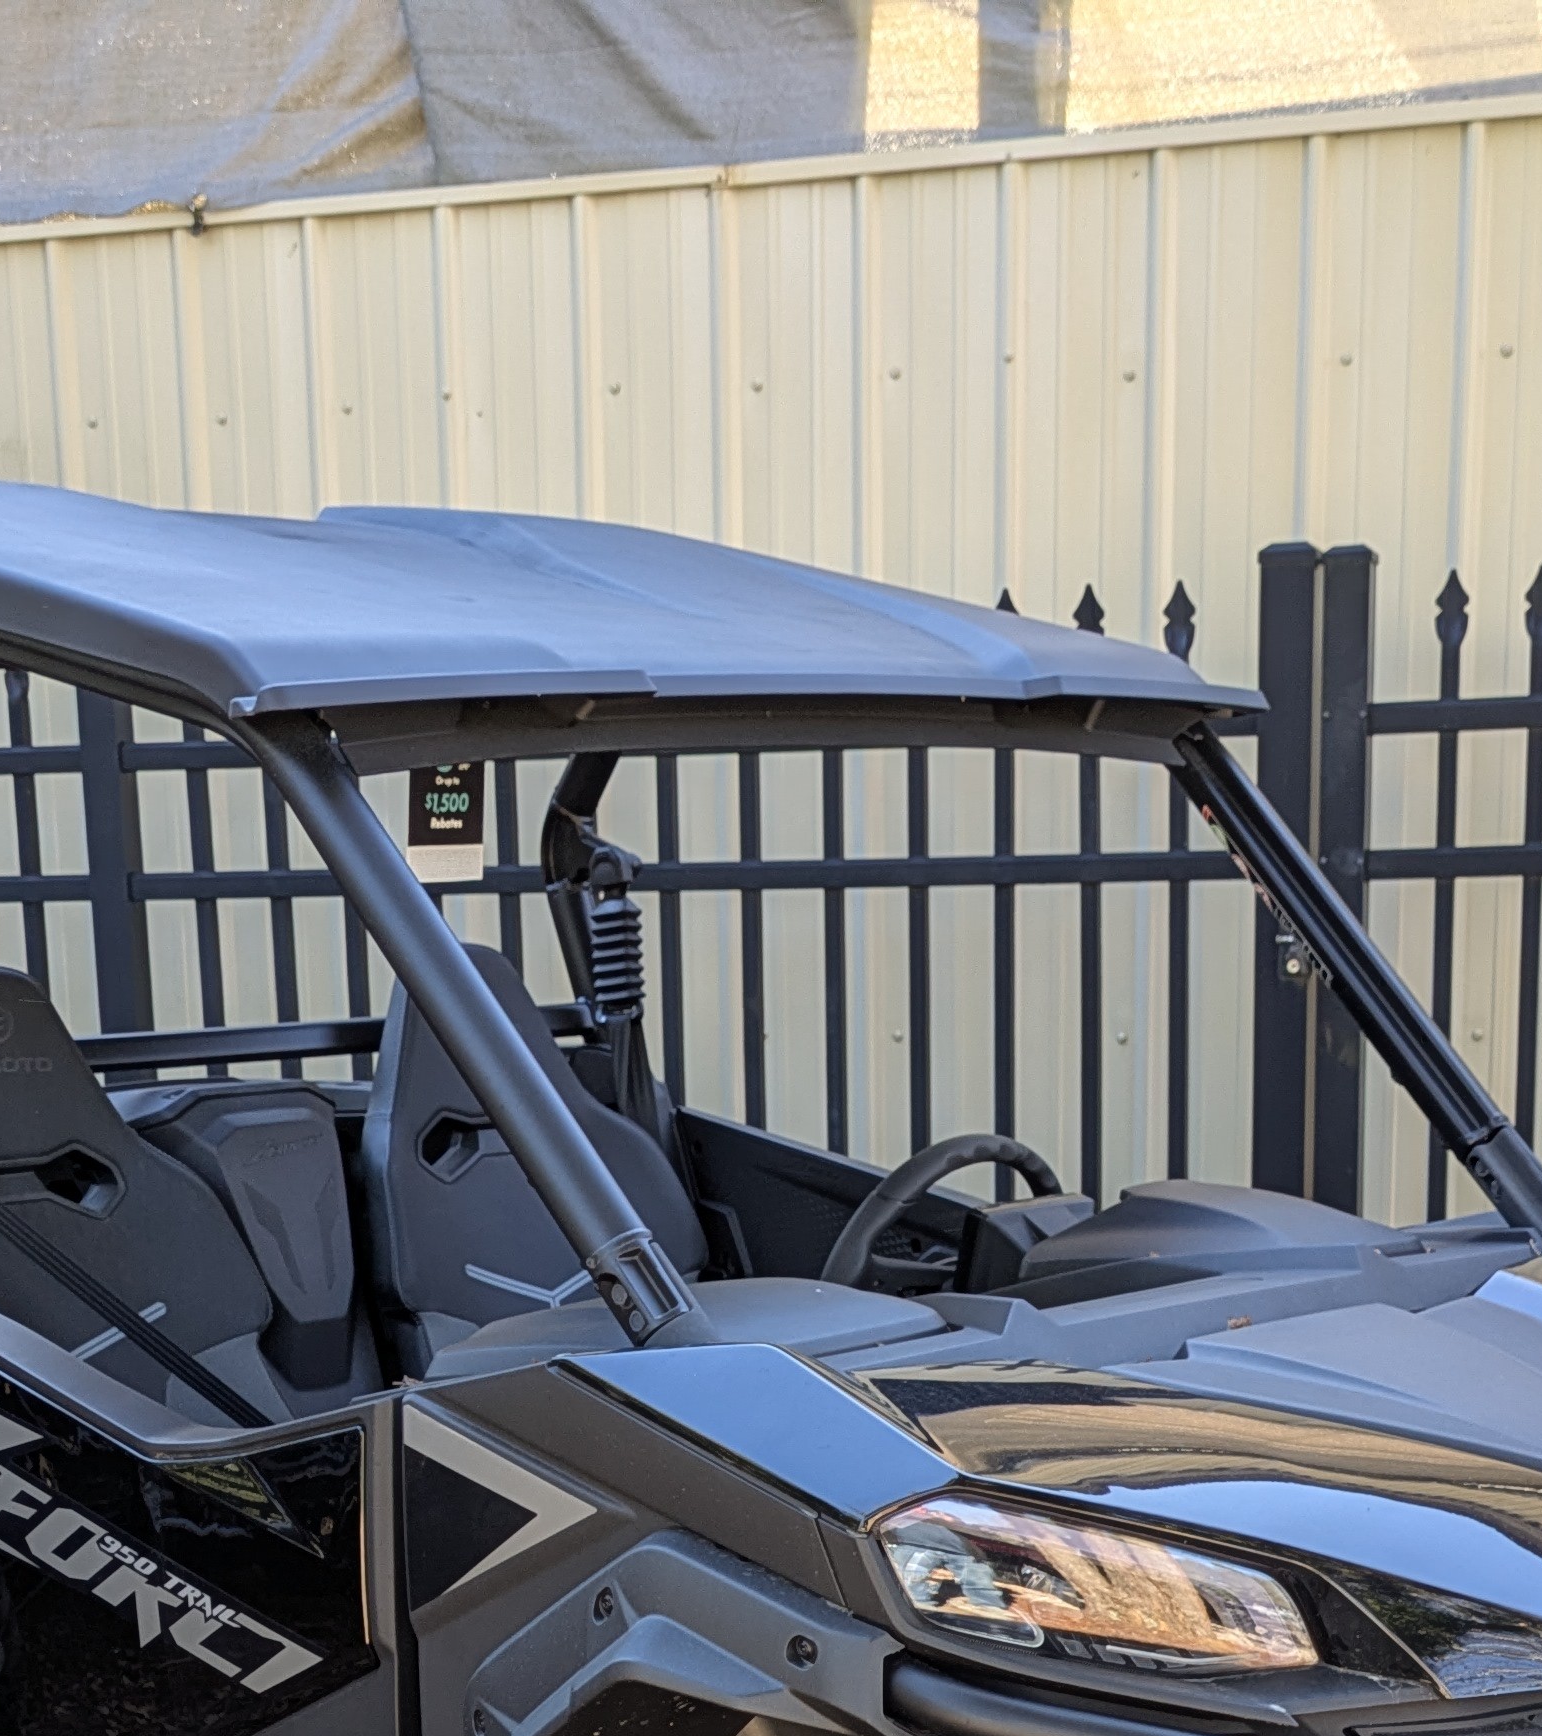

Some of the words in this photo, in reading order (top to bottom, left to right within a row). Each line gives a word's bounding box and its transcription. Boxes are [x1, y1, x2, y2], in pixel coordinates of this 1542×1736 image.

[424, 792, 469, 814] $1,500
[430, 816, 463, 830] Rebates
[99, 1535, 158, 1575] 950
[163, 1570, 241, 1628] TRAIL
